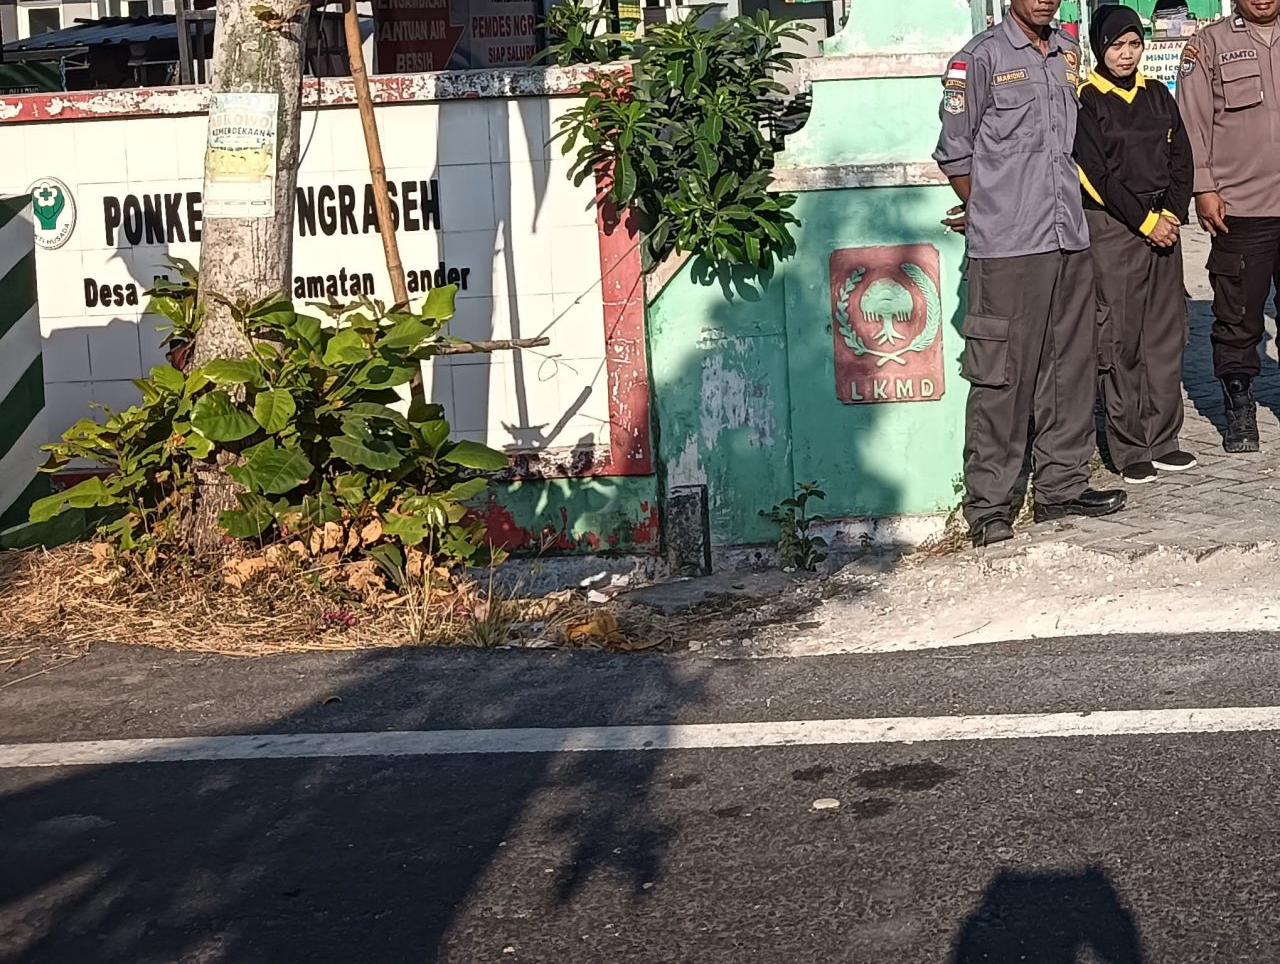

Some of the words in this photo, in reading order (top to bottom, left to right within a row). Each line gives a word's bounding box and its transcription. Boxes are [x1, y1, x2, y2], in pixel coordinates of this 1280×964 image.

[430, 19, 446, 41] AIR
[472, 15, 512, 39] PEMDES
[396, 51, 434, 72] BERSIH
[488, 46, 506, 64] SIAP
[507, 44, 537, 62] SALURK
[1221, 49, 1256, 62] KAMTO
[1143, 64, 1162, 73] Pop
[103, 191, 201, 247] PONKE
[84, 277, 139, 307] Desa
[293, 267, 376, 299] amatan
[406, 266, 471, 293] ander
